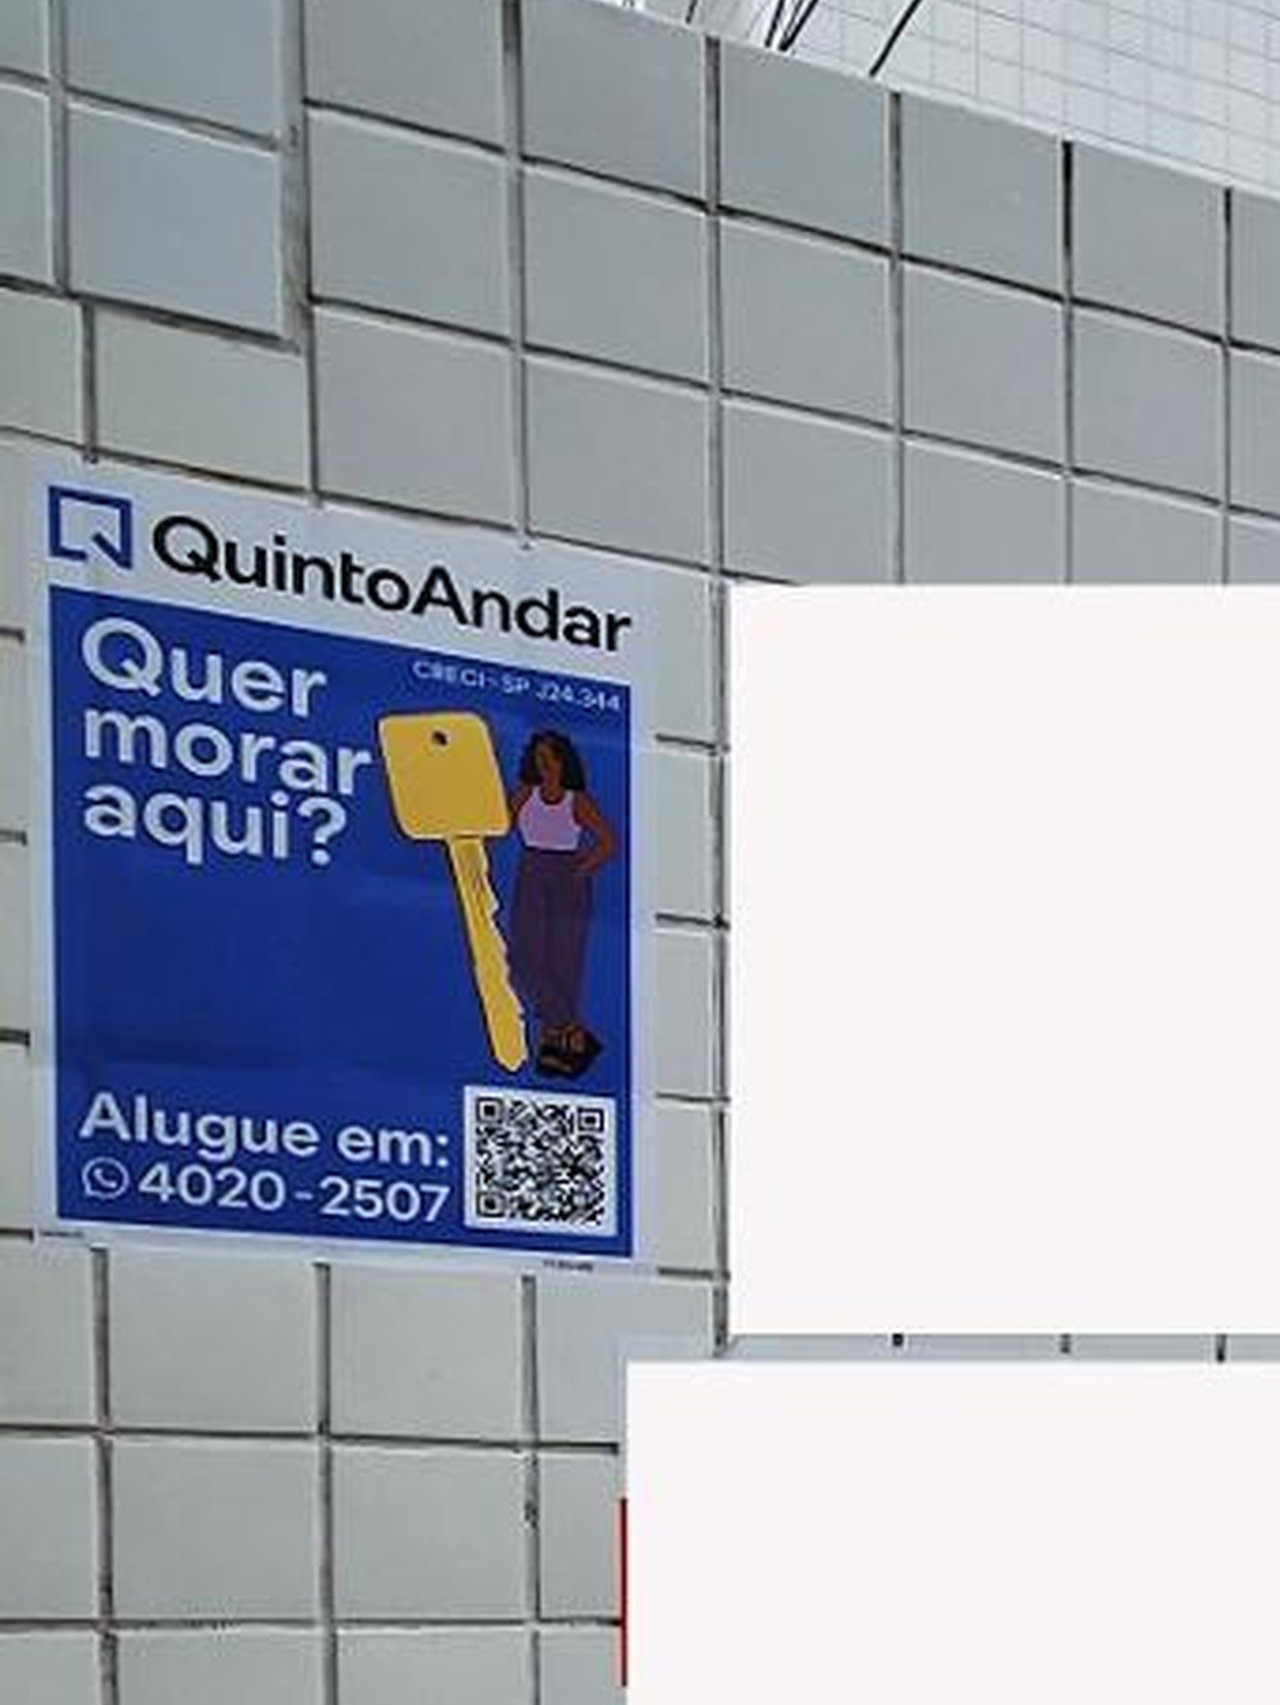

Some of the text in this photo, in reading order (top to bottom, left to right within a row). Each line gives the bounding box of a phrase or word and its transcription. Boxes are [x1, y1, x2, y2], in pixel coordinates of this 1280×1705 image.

[152, 515, 632, 652] QuintoAndar
[81, 616, 326, 717] Quer
[84, 706, 373, 795] morar
[84, 783, 348, 866] aqui?
[80, 1091, 451, 1168] Alugue em:
